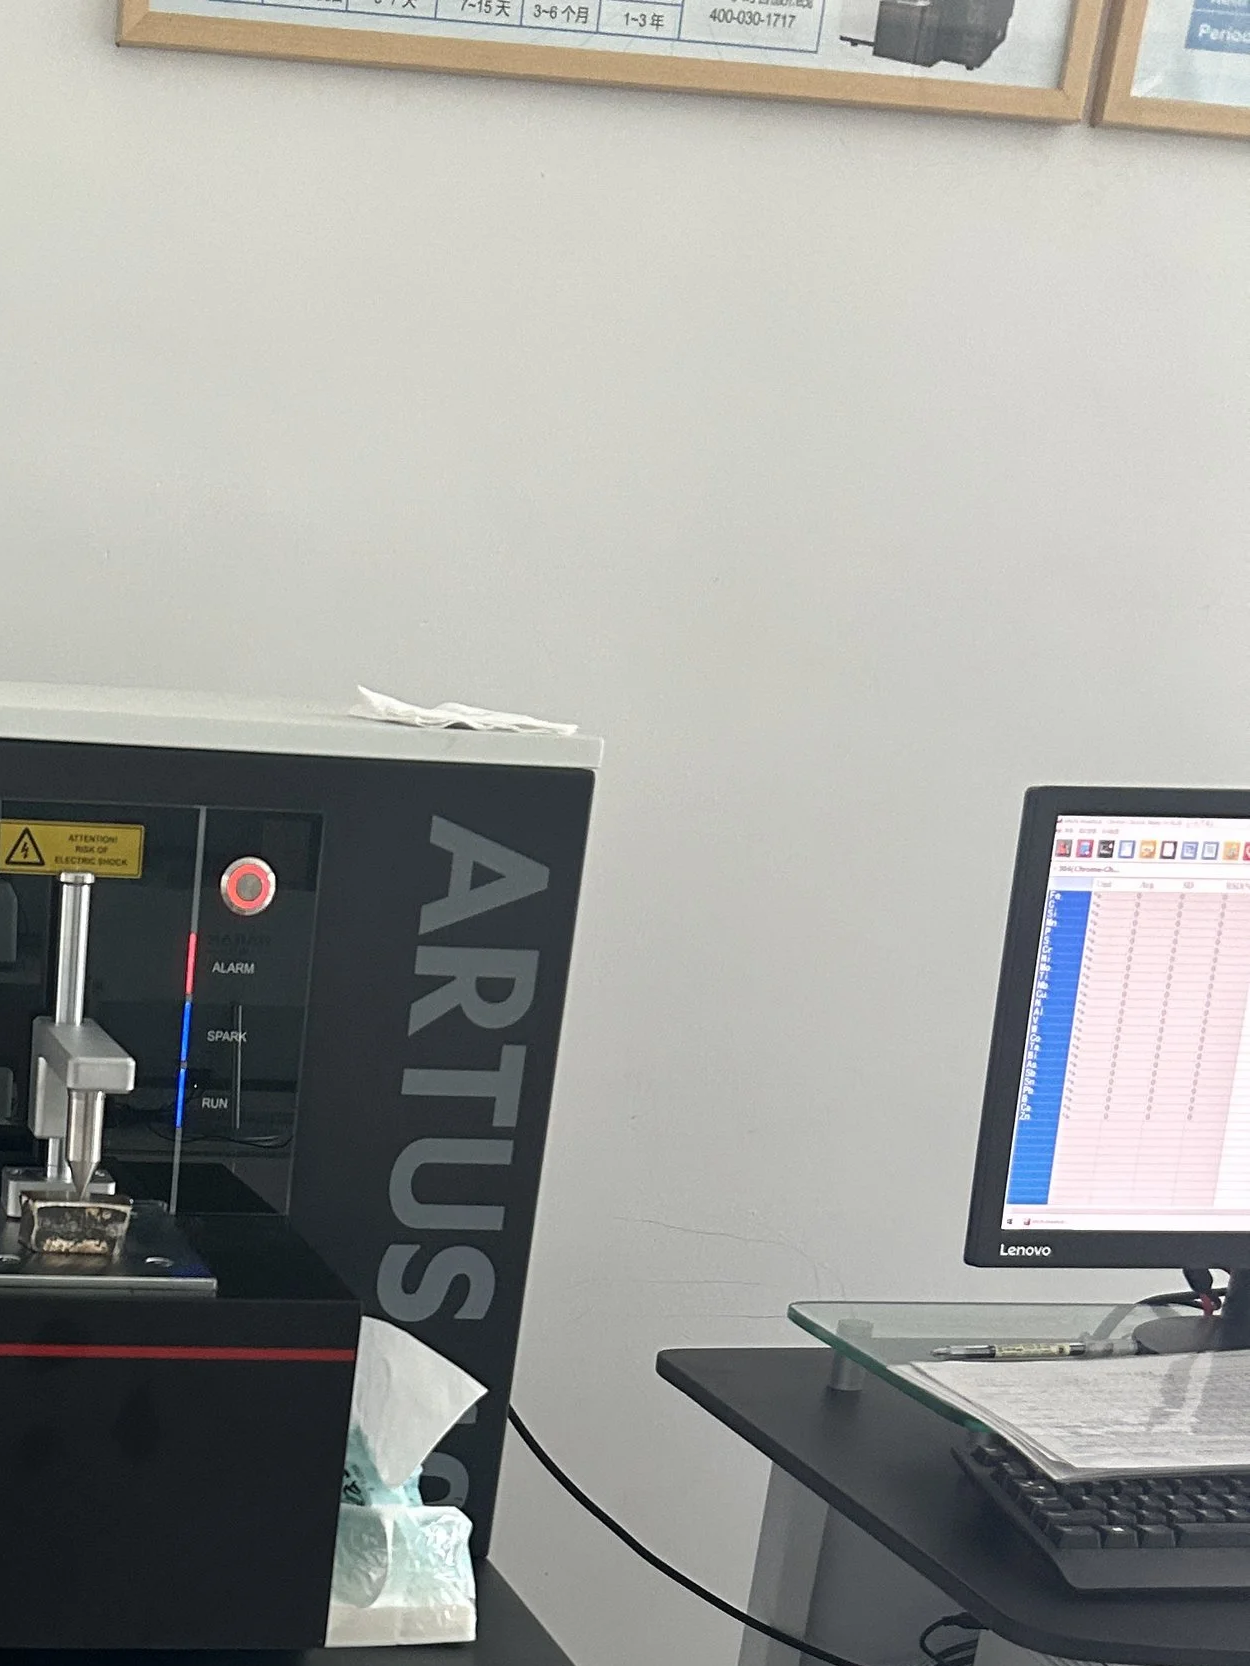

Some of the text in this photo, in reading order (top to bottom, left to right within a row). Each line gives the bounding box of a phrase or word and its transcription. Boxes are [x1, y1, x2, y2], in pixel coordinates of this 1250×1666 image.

[709, 8, 796, 28] 400-030-1717
[54, 856, 96, 865] ELECTRIC
[212, 961, 255, 974] ALARM
[207, 1030, 247, 1042] SPARK
[376, 814, 550, 1322] ARTUS
[202, 1097, 228, 1109] RUN
[1000, 1243, 1052, 1256] Lenovo
